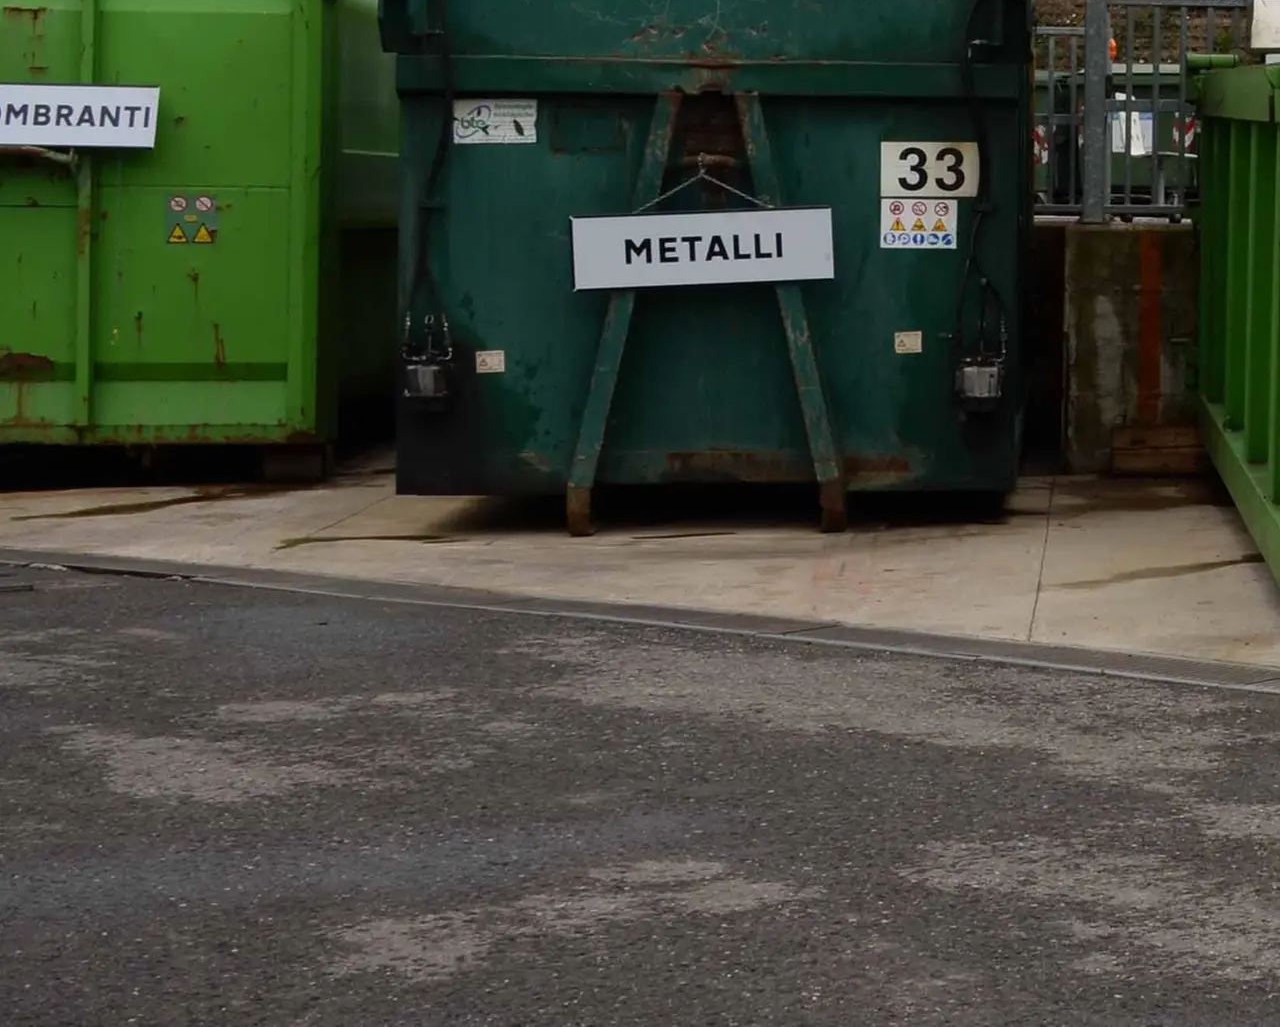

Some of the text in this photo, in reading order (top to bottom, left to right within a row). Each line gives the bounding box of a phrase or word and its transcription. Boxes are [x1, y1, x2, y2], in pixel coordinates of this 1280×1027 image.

[0, 103, 151, 128] MBRANTI
[898, 147, 966, 191] 33
[624, 232, 783, 265] METALLI
